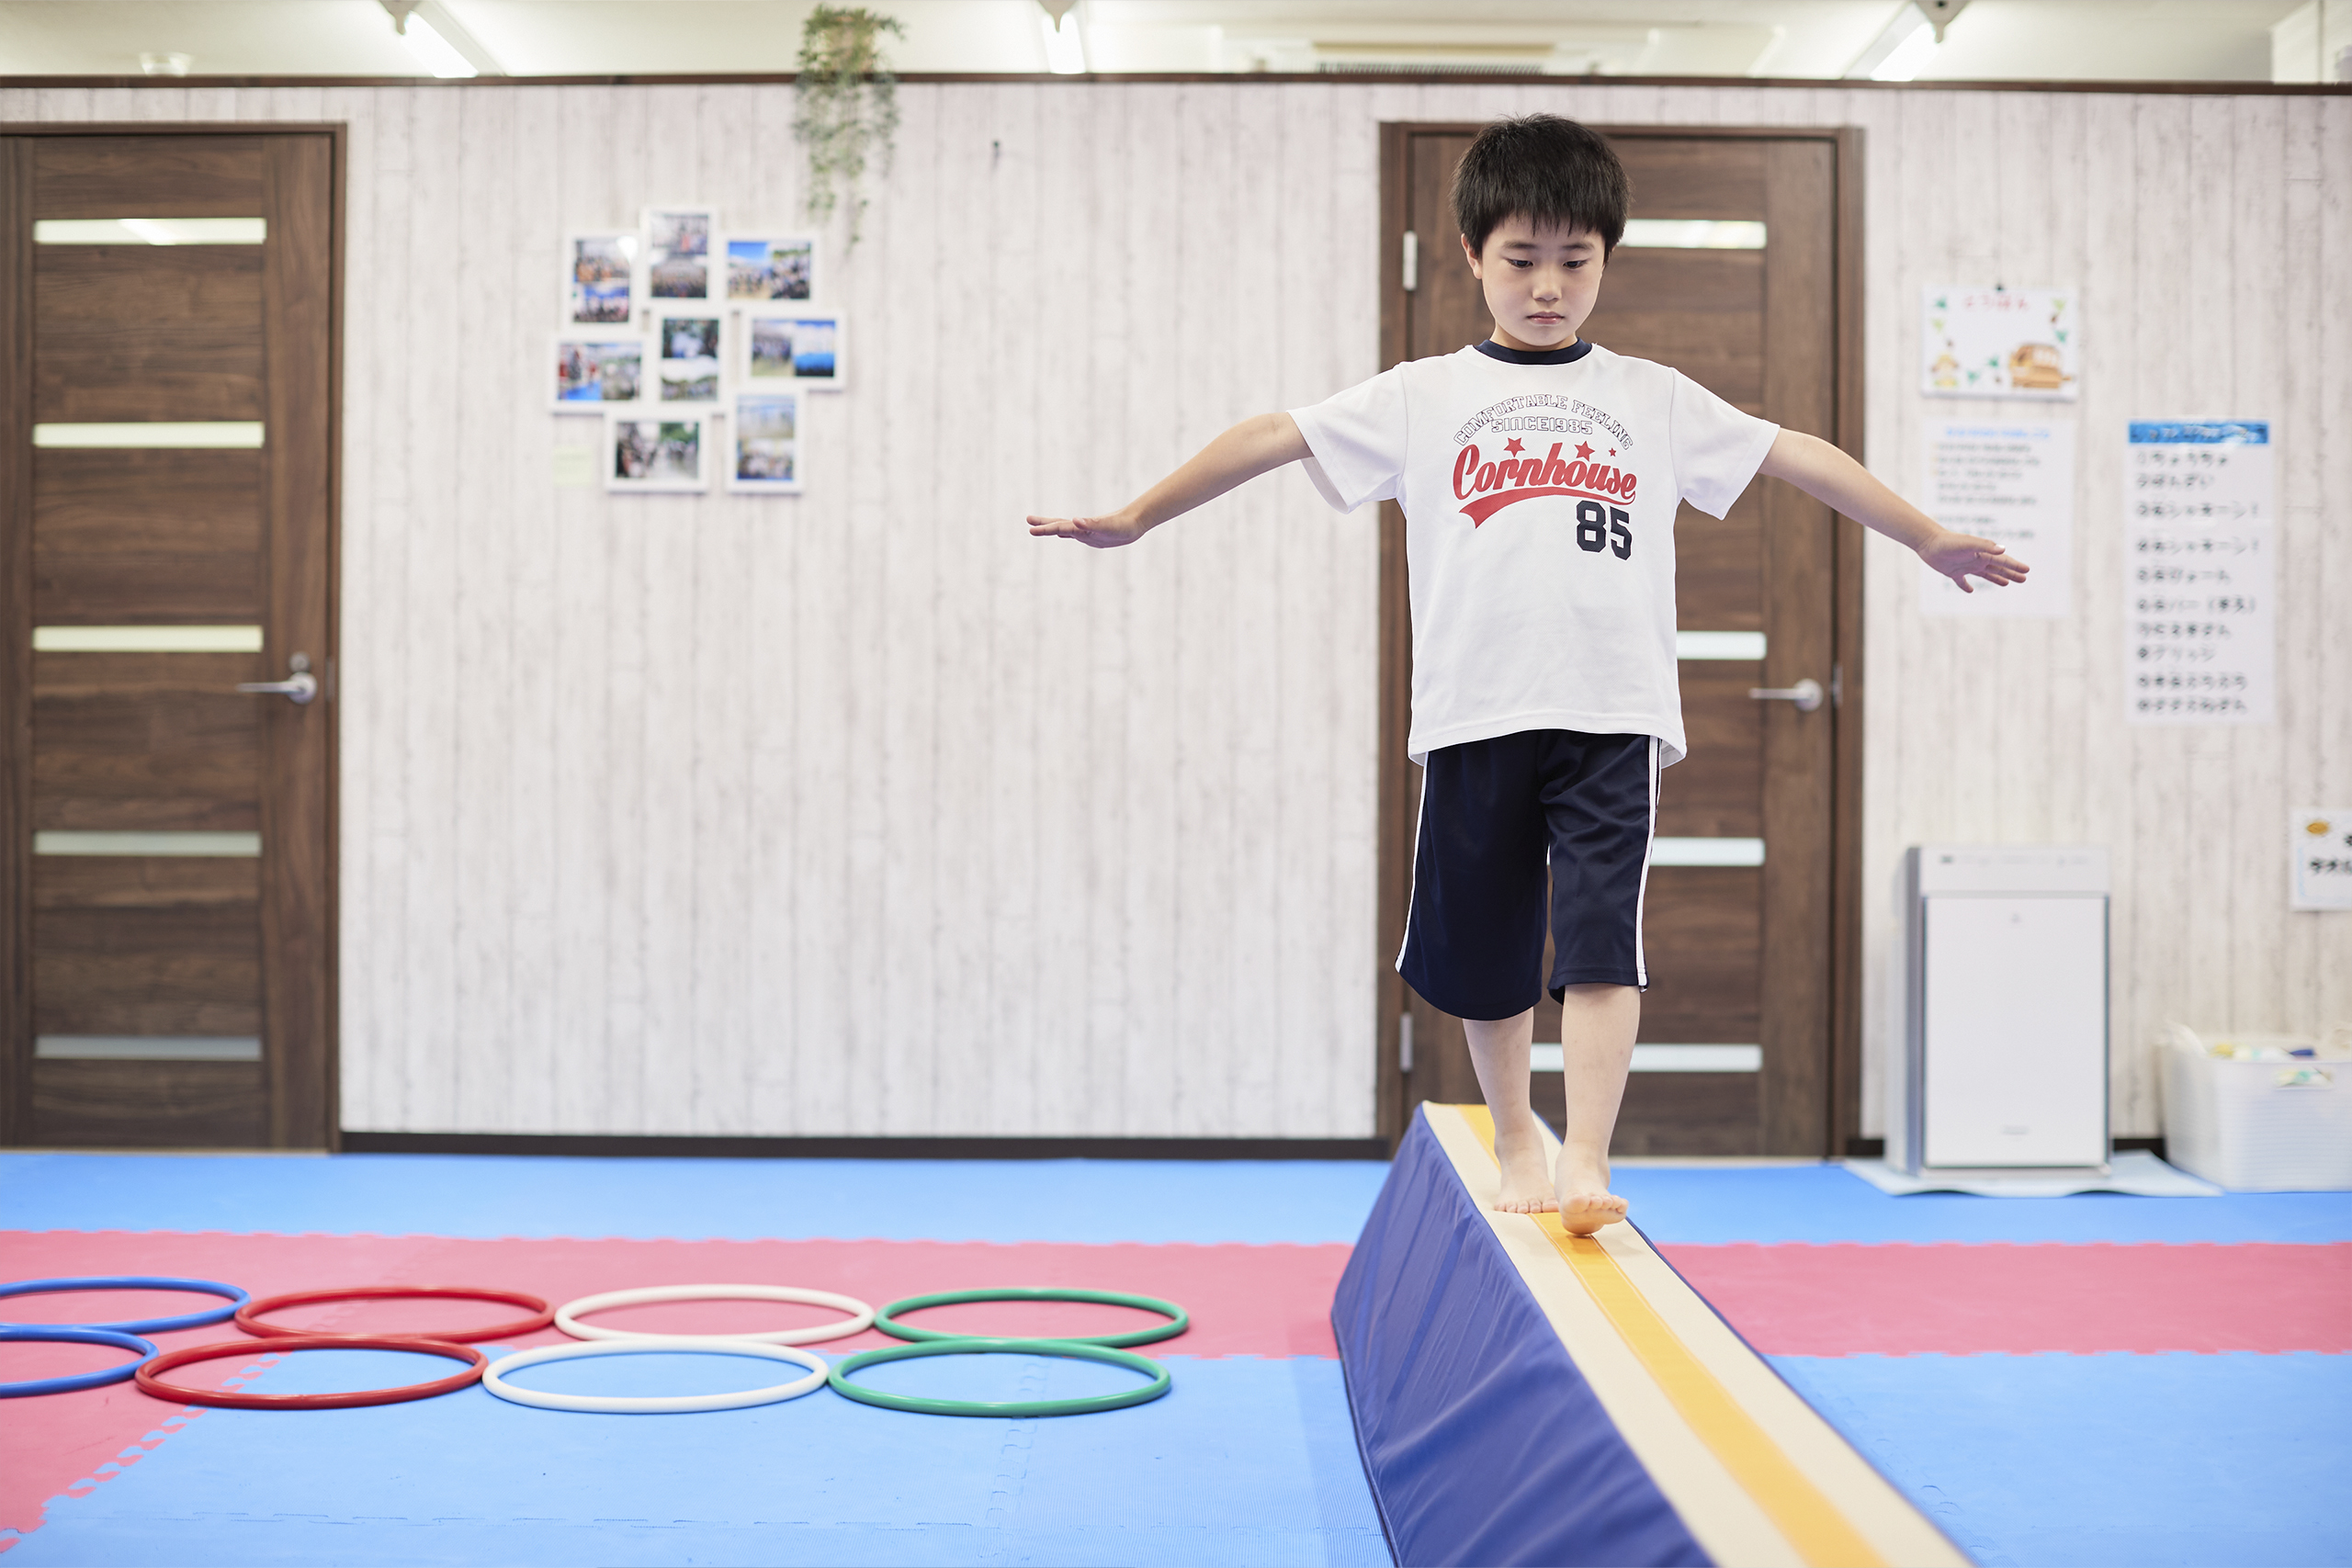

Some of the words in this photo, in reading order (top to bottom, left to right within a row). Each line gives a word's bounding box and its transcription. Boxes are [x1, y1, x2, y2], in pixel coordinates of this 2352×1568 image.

[1453, 394, 1568, 446] COMFORTABLE
[1571, 399, 1634, 451] FEELING
[1453, 442, 1637, 501] Cornhouse
[1575, 500, 1633, 561] 85
